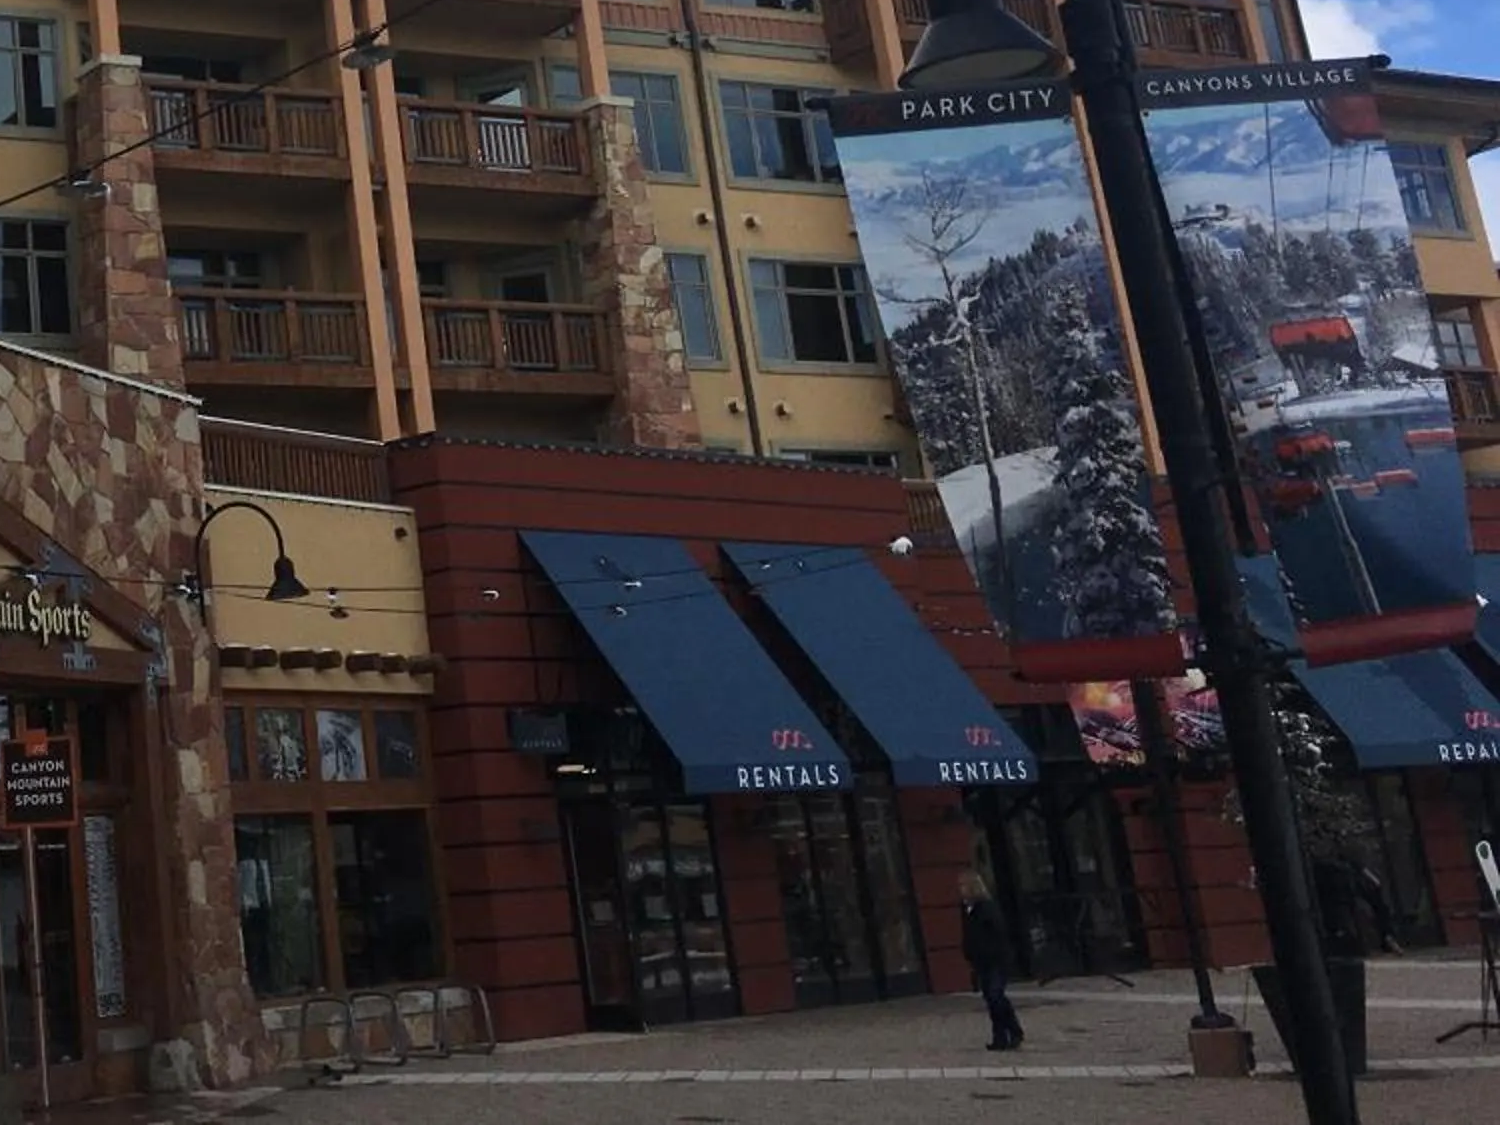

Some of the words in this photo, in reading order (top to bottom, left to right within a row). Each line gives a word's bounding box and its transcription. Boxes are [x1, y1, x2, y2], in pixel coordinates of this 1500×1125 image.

[1146, 73, 1254, 96] CANYONS
[1262, 67, 1357, 88] VILLAGE
[902, 95, 975, 120] PARK
[987, 87, 1053, 113] CITY
[27, 588, 93, 647] Sports
[11, 759, 65, 775] CANYON
[737, 763, 840, 789] RENTALS
[938, 759, 1028, 783] RENTALS
[6, 775, 71, 792] MOUNTAIN
[14, 791, 64, 807] SPORTS
